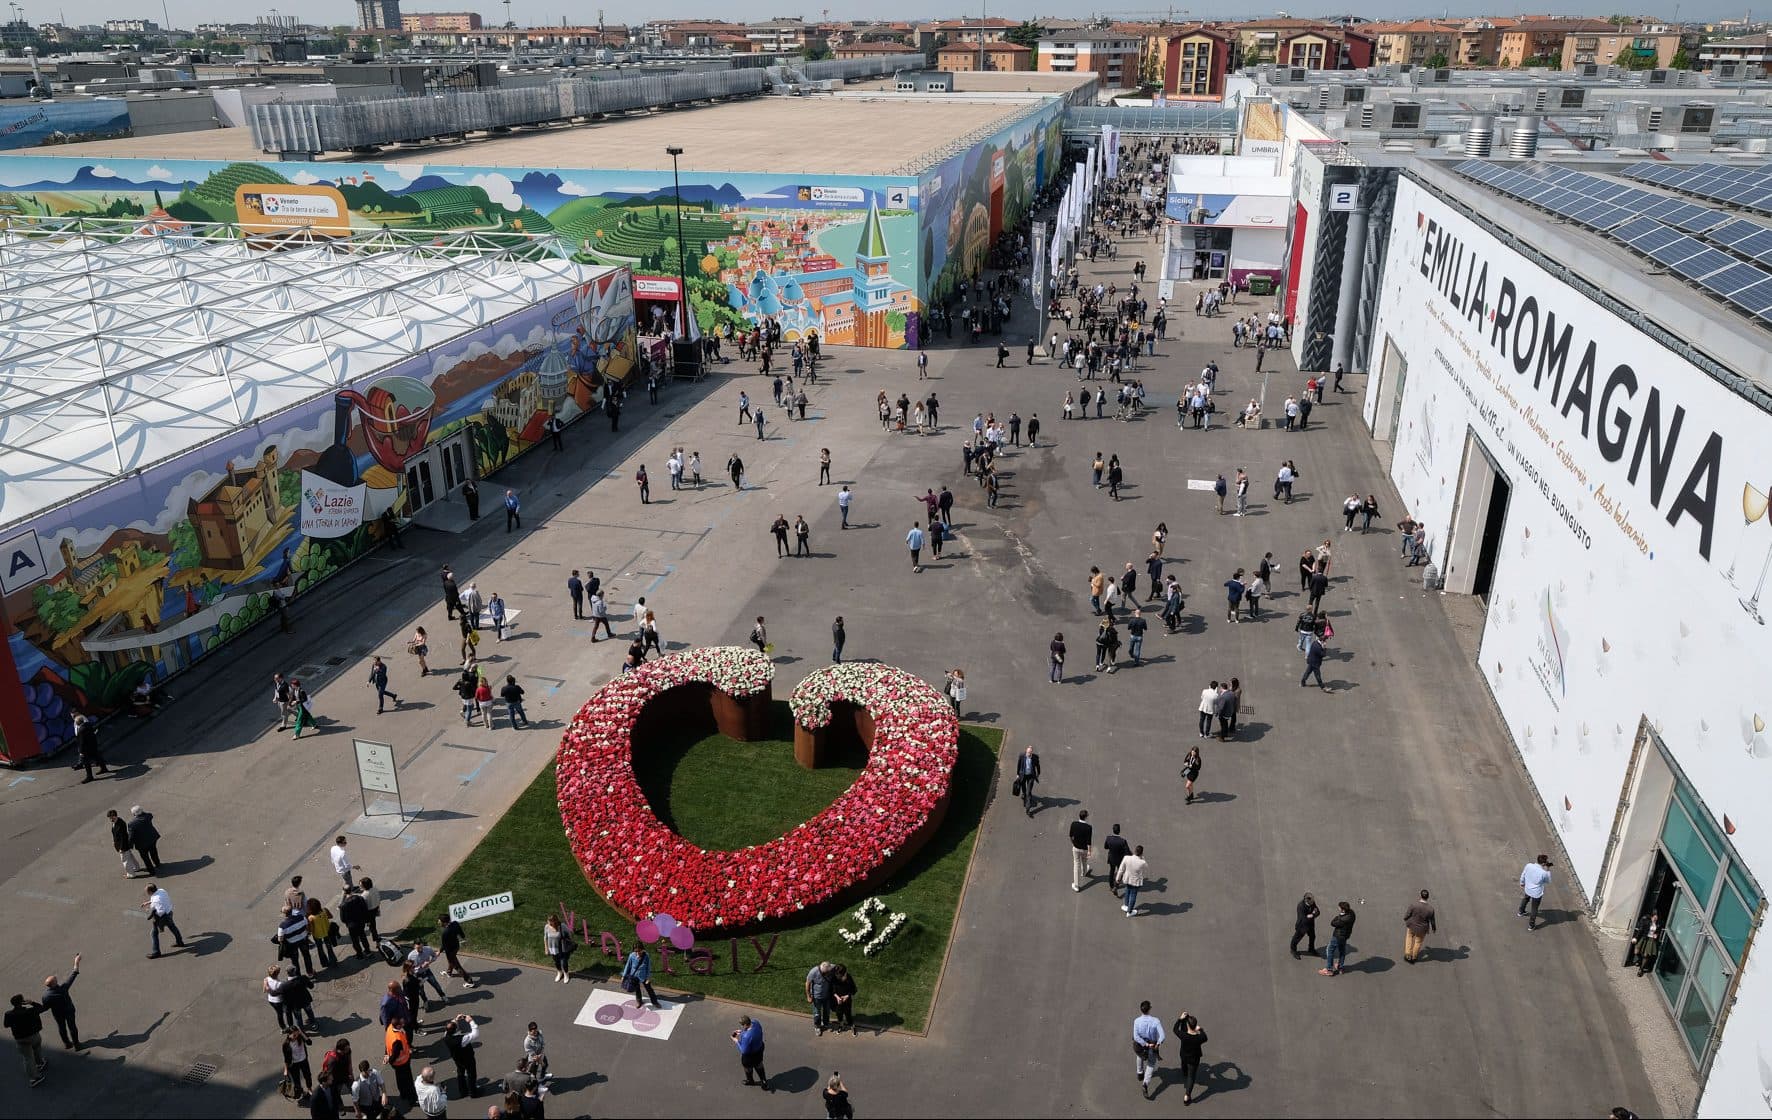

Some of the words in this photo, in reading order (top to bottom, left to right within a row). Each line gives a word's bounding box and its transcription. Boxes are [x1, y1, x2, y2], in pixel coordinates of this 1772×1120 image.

[891, 193, 904, 204] 4
[1169, 196, 1193, 204] Sicilia
[1337, 192, 1351, 204] 2
[621, 280, 628, 293] A
[1420, 218, 1489, 334] EMILIA
[1490, 276, 1723, 562] ROMAGNA
[1465, 385, 1478, 409] EMILIA
[1507, 439, 1515, 456] UN
[1515, 450, 1539, 484] VIAGGIO
[1538, 480, 1550, 500] NEL
[1551, 494, 1591, 550] BUONGUSTO
[9, 549, 36, 578] A
[469, 895, 510, 911] amia
